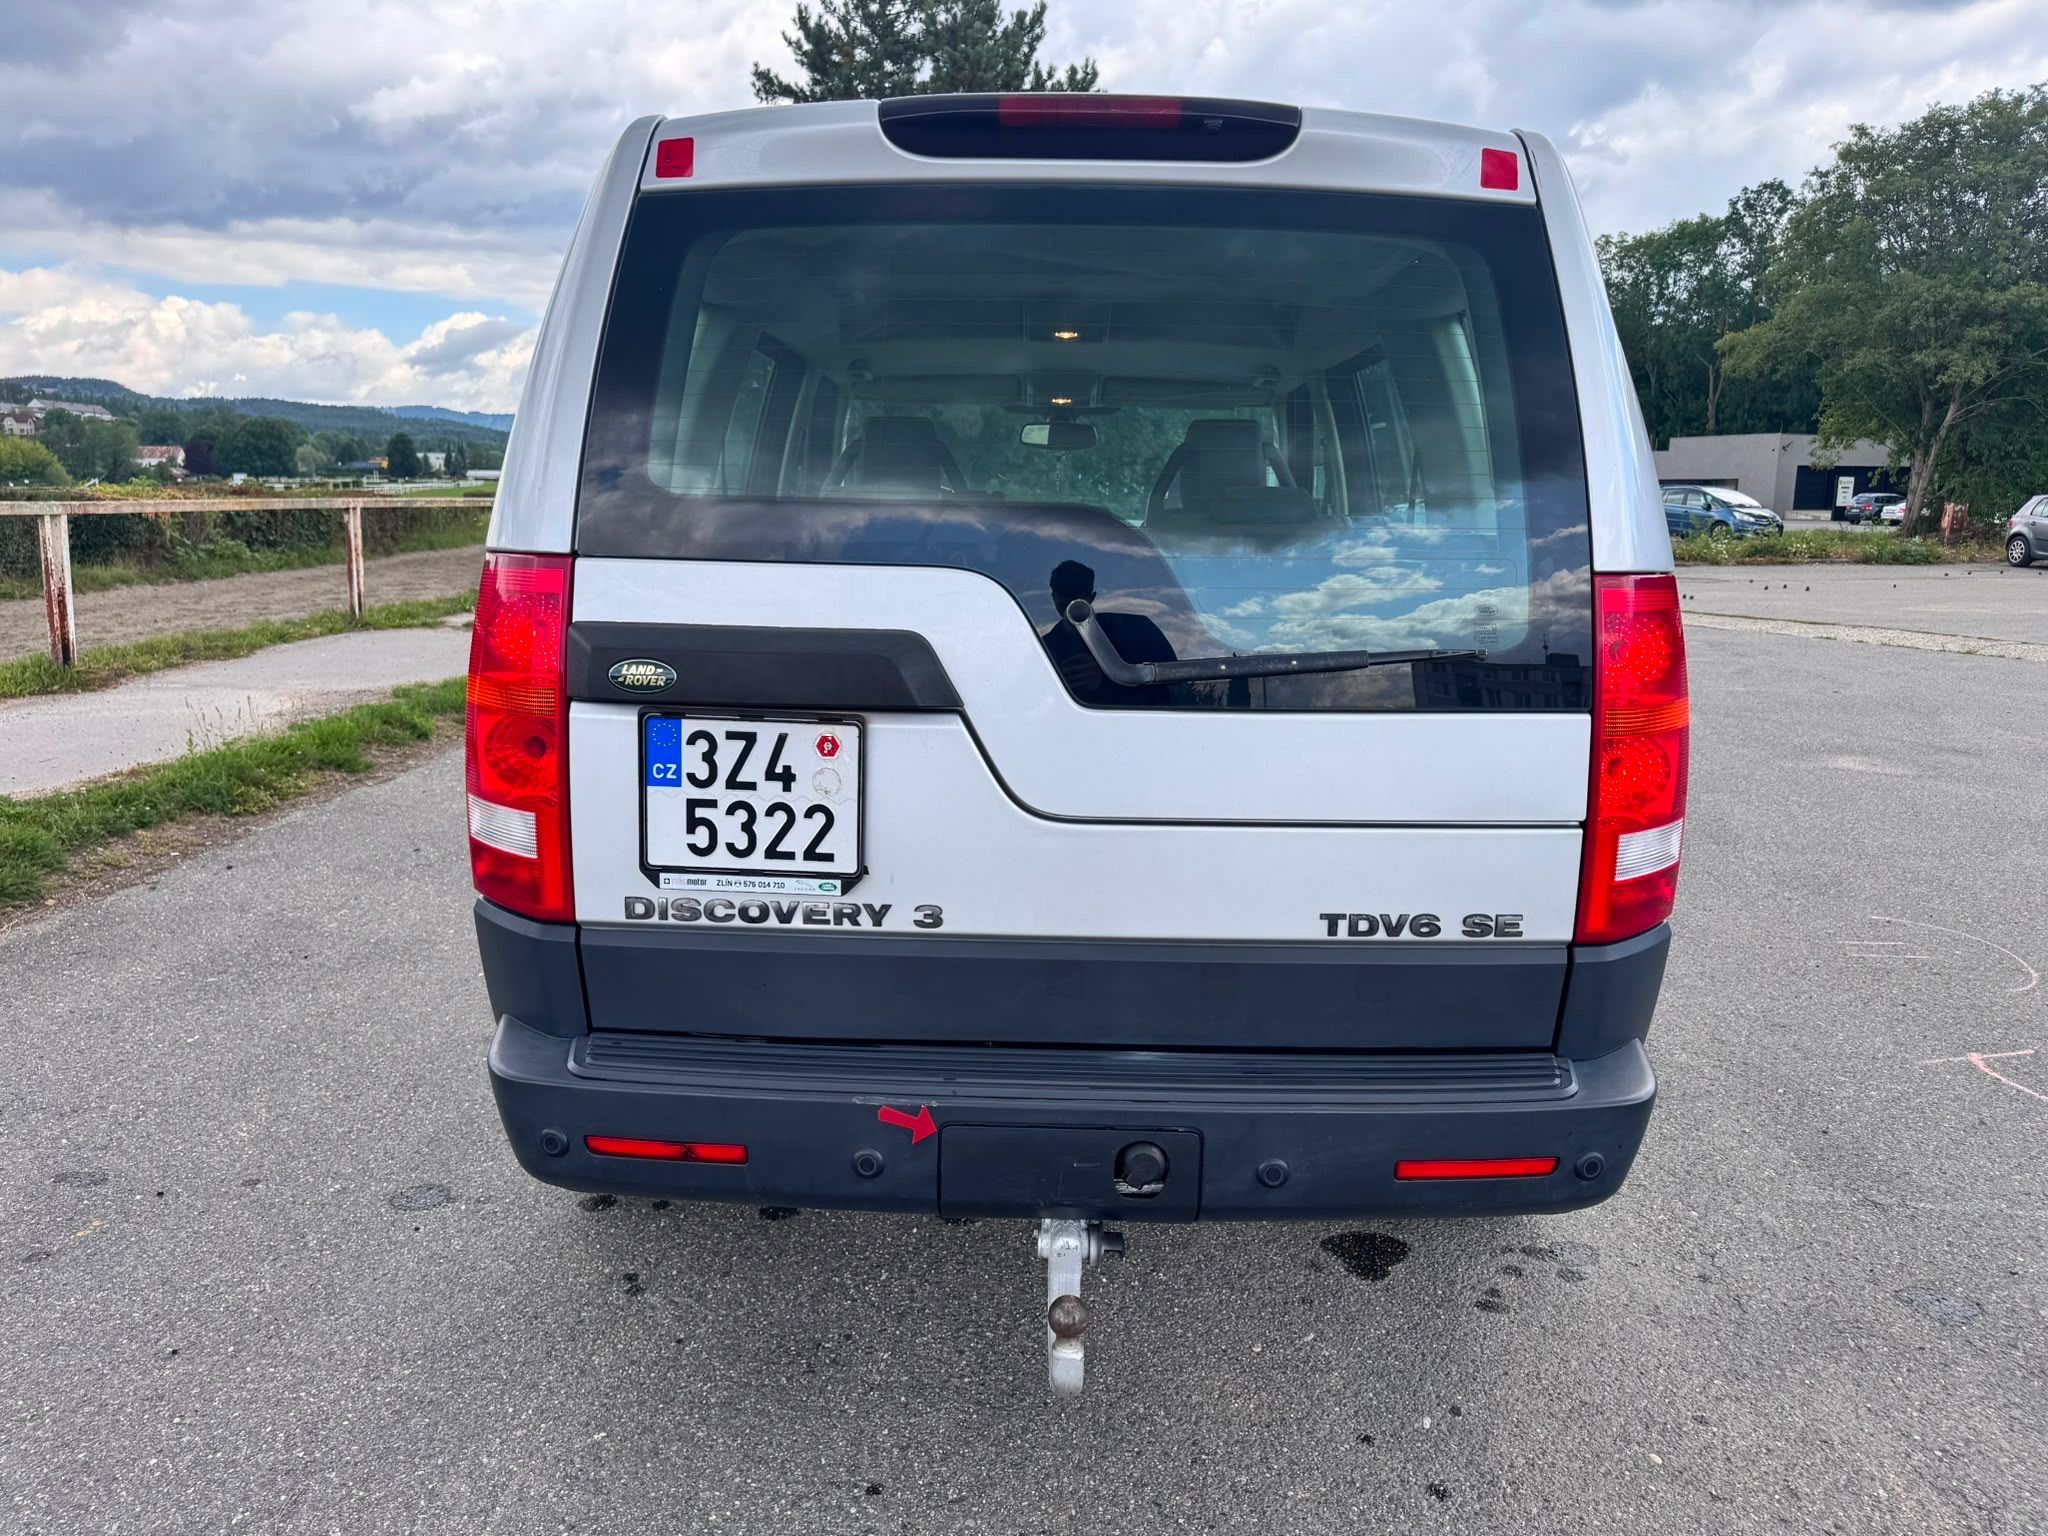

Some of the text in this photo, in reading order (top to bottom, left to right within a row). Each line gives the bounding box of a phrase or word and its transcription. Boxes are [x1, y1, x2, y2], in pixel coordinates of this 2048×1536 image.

[621, 664, 656, 675] LAND
[624, 675, 667, 686] ROVER
[685, 729, 797, 793] 3Z4
[652, 764, 677, 780] CZ
[685, 798, 835, 863] 5322
[757, 881, 771, 889] 014
[624, 896, 945, 929] DISCOVERY 3
[1319, 913, 1524, 938] TDV6 SE
